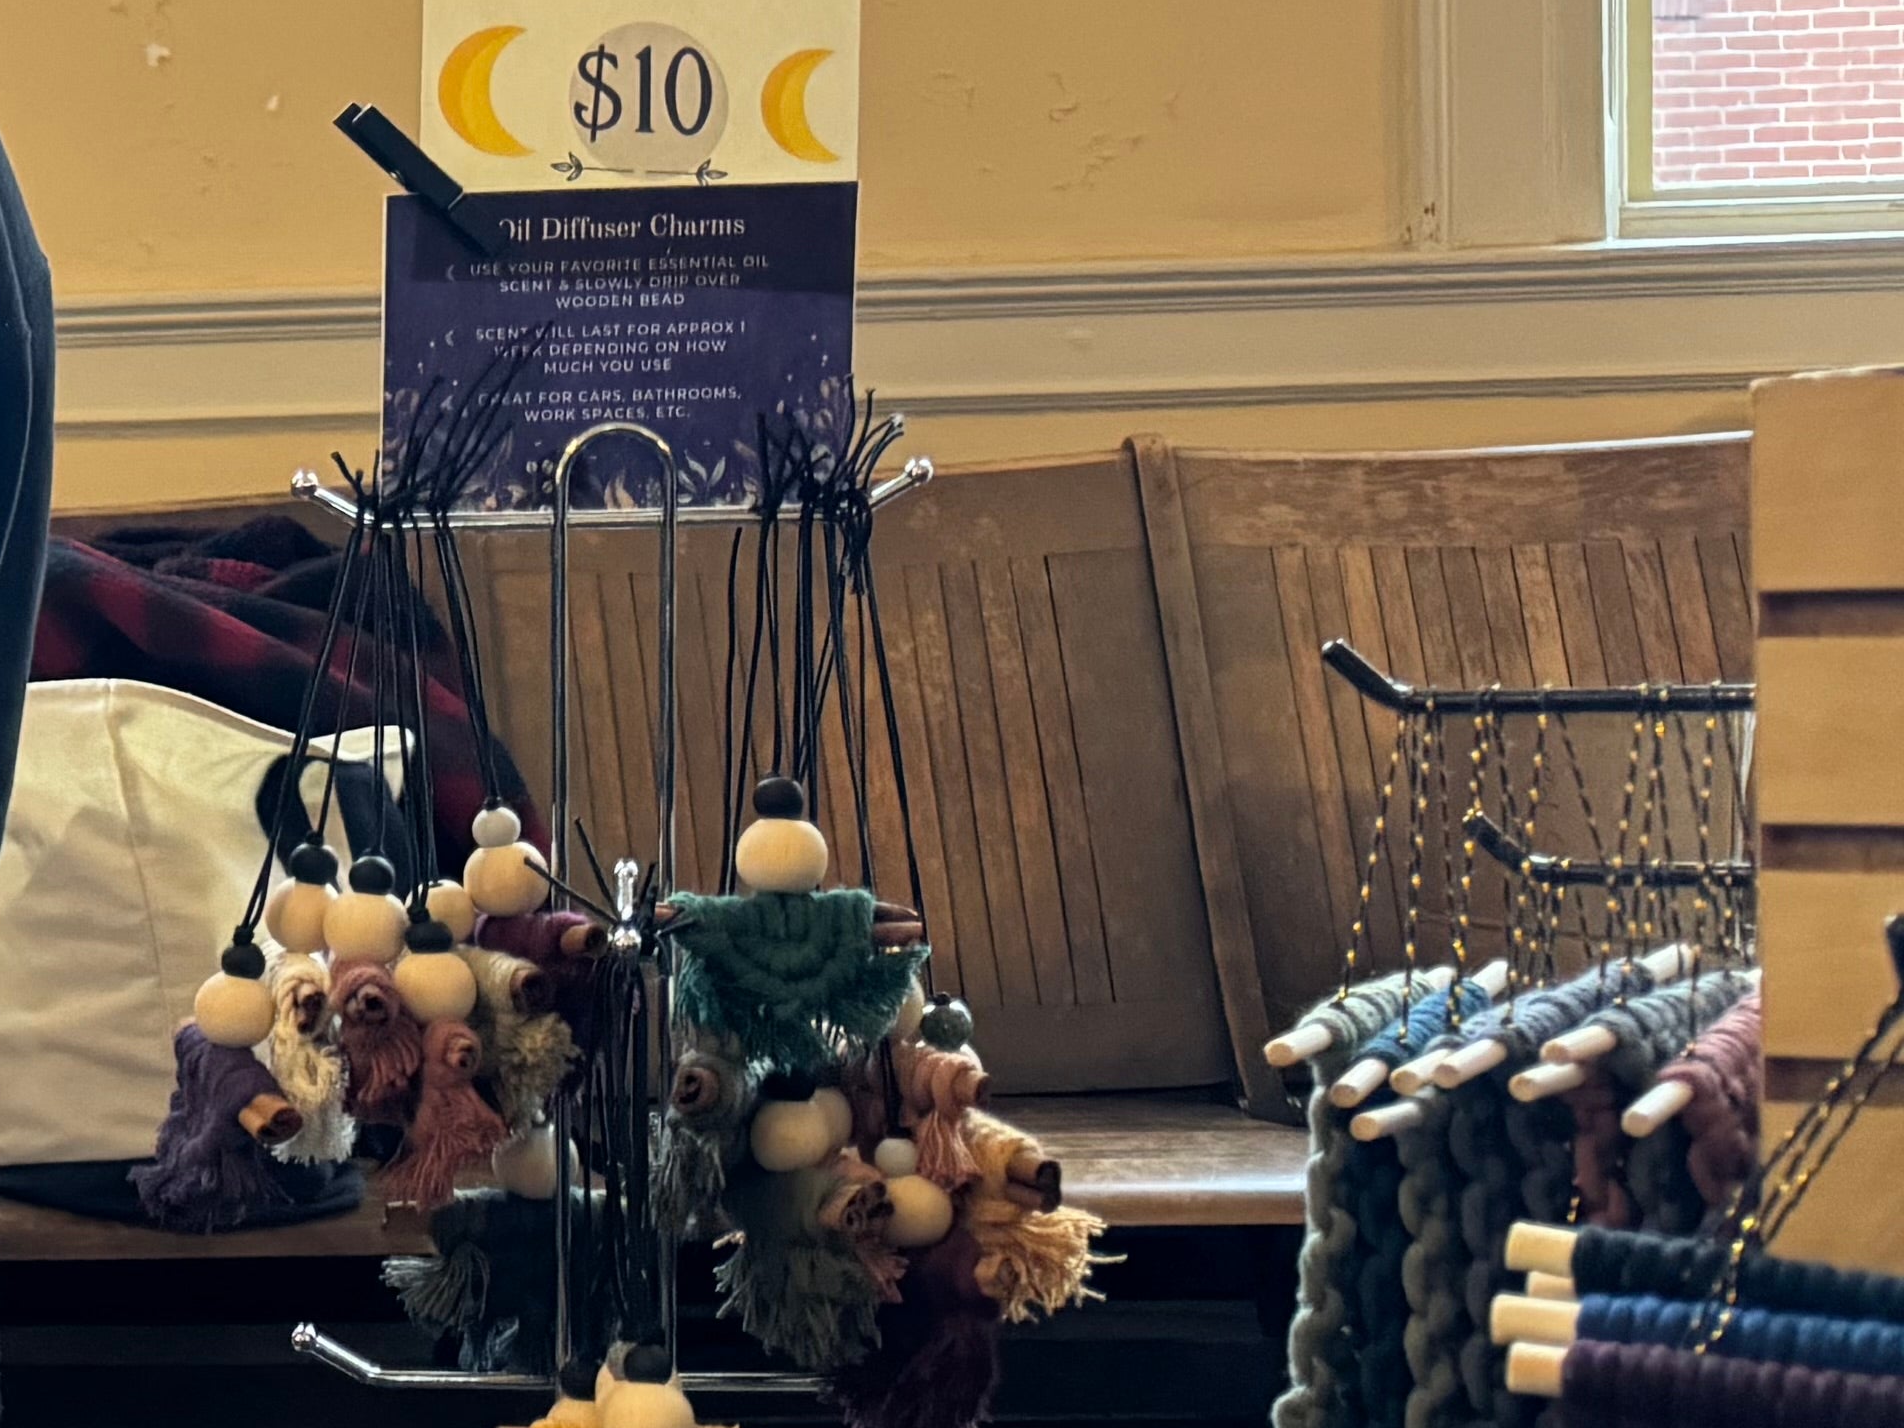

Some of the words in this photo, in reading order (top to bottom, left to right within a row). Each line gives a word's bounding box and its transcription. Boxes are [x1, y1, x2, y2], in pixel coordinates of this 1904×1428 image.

[573, 43, 713, 143] $10
[542, 215, 642, 241] Diffuser
[650, 212, 746, 238] Charms
[470, 263, 501, 276] USE
[508, 261, 554, 275] YOUR
[560, 258, 641, 274] FAVORITE
[648, 254, 736, 271] ESSENTIAL
[742, 253, 770, 269] OIL
[499, 278, 552, 293] SCENT
[575, 276, 643, 292] SLOWLY
[648, 274, 689, 289] DRIP
[694, 273, 741, 287] OVER
[555, 295, 634, 311] WOODEN
[639, 293, 686, 307] BEAD
[581, 323, 622, 339] LAST
[626, 322, 661, 338] FOR
[666, 321, 735, 336] APPROX
[549, 341, 650, 357] DEPENDING
[655, 341, 679, 354] ON
[686, 339, 727, 353] HOW
[544, 360, 594, 375] MUCH
[599, 359, 635, 373] YOU
[641, 358, 672, 372] USE
[538, 390, 572, 406] FOR
[525, 408, 576, 423] WORK
